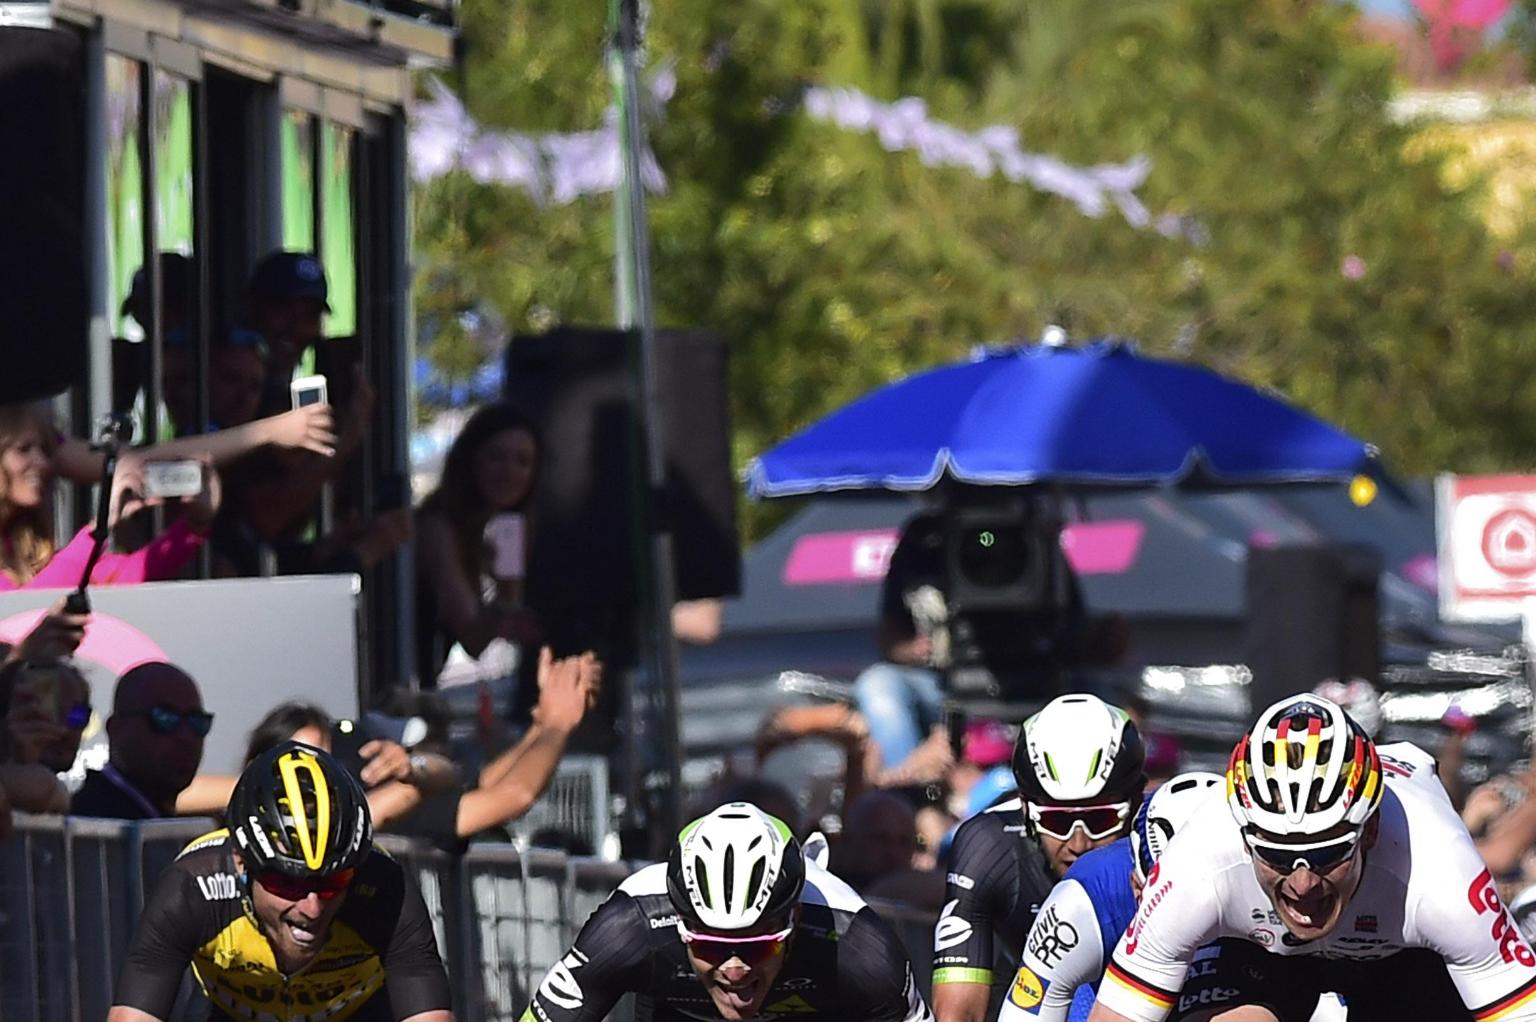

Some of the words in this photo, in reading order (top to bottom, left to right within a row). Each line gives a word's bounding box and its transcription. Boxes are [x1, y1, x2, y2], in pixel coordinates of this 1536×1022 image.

[1030, 742, 1049, 780] MET
[1100, 737, 1117, 781] MET
[686, 865, 704, 909] MET
[755, 867, 775, 912] MET
[1034, 921, 1079, 970] PRO
